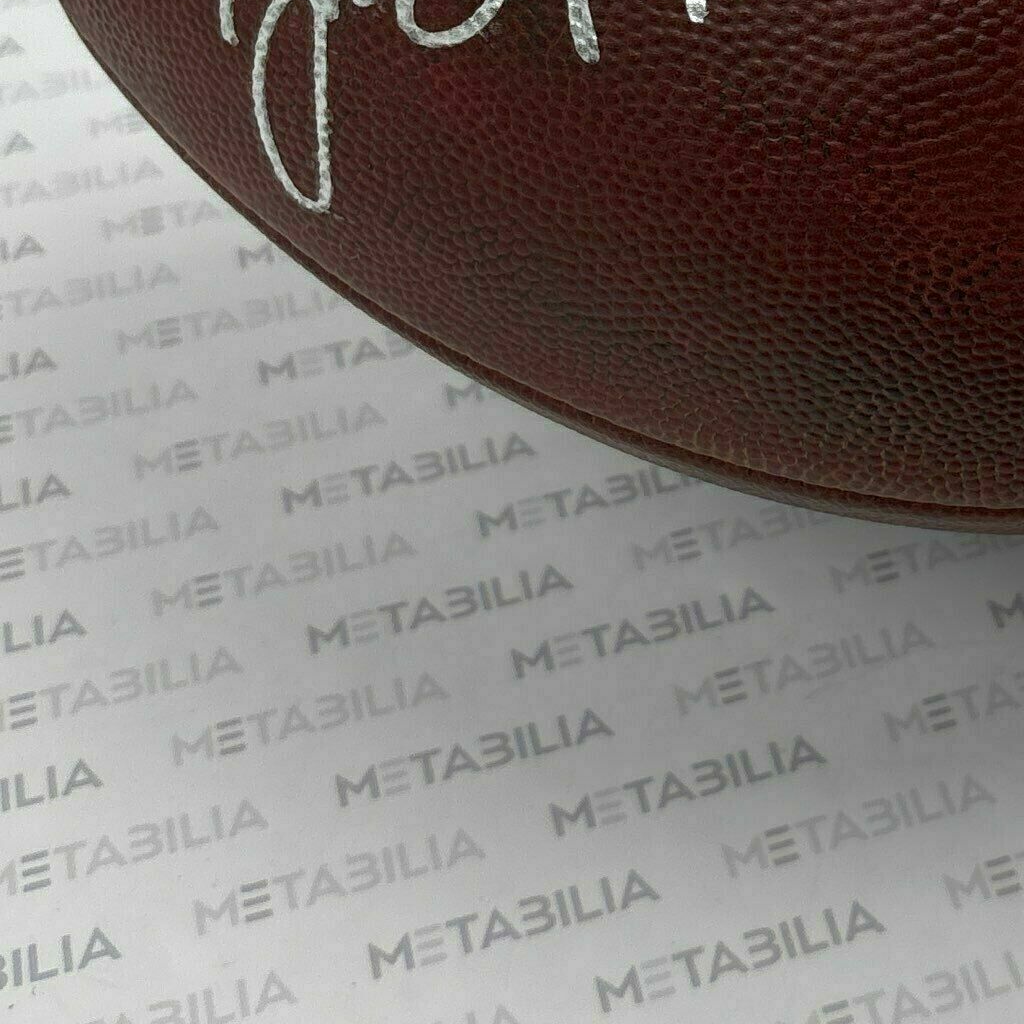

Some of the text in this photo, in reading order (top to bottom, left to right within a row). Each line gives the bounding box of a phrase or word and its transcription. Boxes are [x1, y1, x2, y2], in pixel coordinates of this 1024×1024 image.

[0, 261, 181, 320] TABILIA
[134, 400, 389, 479] METABILIA
[281, 431, 537, 513] METABILIA
[150, 532, 418, 617] METABILIA
[307, 564, 575, 655] METABILIA
[510, 585, 776, 680] METABILIA
[0, 646, 244, 732] ETABILIA
[172, 672, 452, 767] METABILIA
[335, 708, 616, 807] METABILIA
[547, 734, 828, 837] METABILIA
[720, 775, 997, 878] METABILIA
[192, 827, 487, 937] METABILIA
[368, 868, 661, 980] METABILIA
[594, 900, 887, 1013] METABILIA
